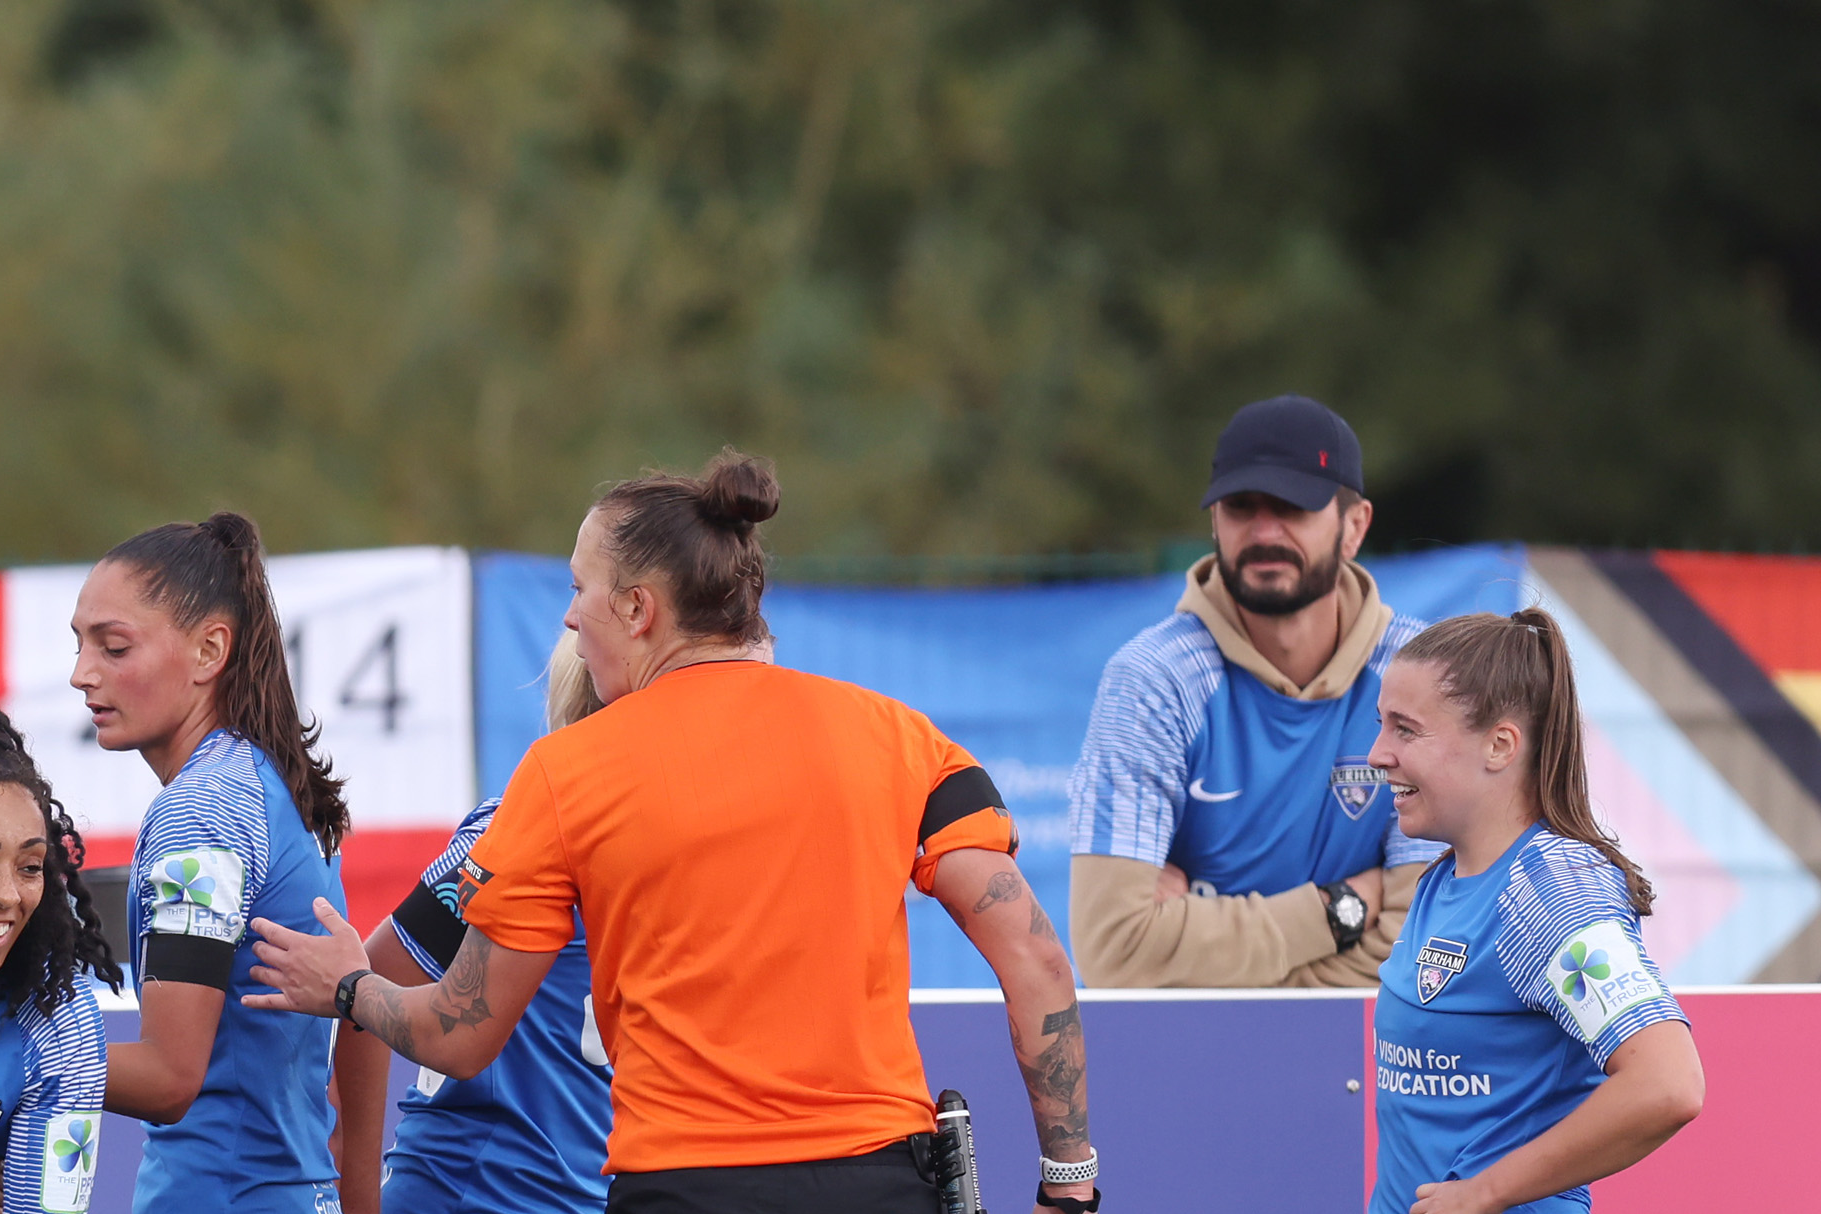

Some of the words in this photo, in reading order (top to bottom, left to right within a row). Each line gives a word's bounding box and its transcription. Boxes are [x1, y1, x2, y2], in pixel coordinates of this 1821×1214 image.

[195, 909, 240, 927] PFC
[194, 926, 235, 938] TRUS
[1419, 949, 1463, 970] DURHAM
[1599, 970, 1649, 1001] PFC
[1607, 983, 1655, 1008] TRUST
[1580, 995, 1596, 1012] THE
[1379, 1039, 1423, 1069] VISION
[1426, 1049, 1461, 1070] for
[1377, 1066, 1491, 1096] EDUCATION
[57, 1176, 77, 1185] THE
